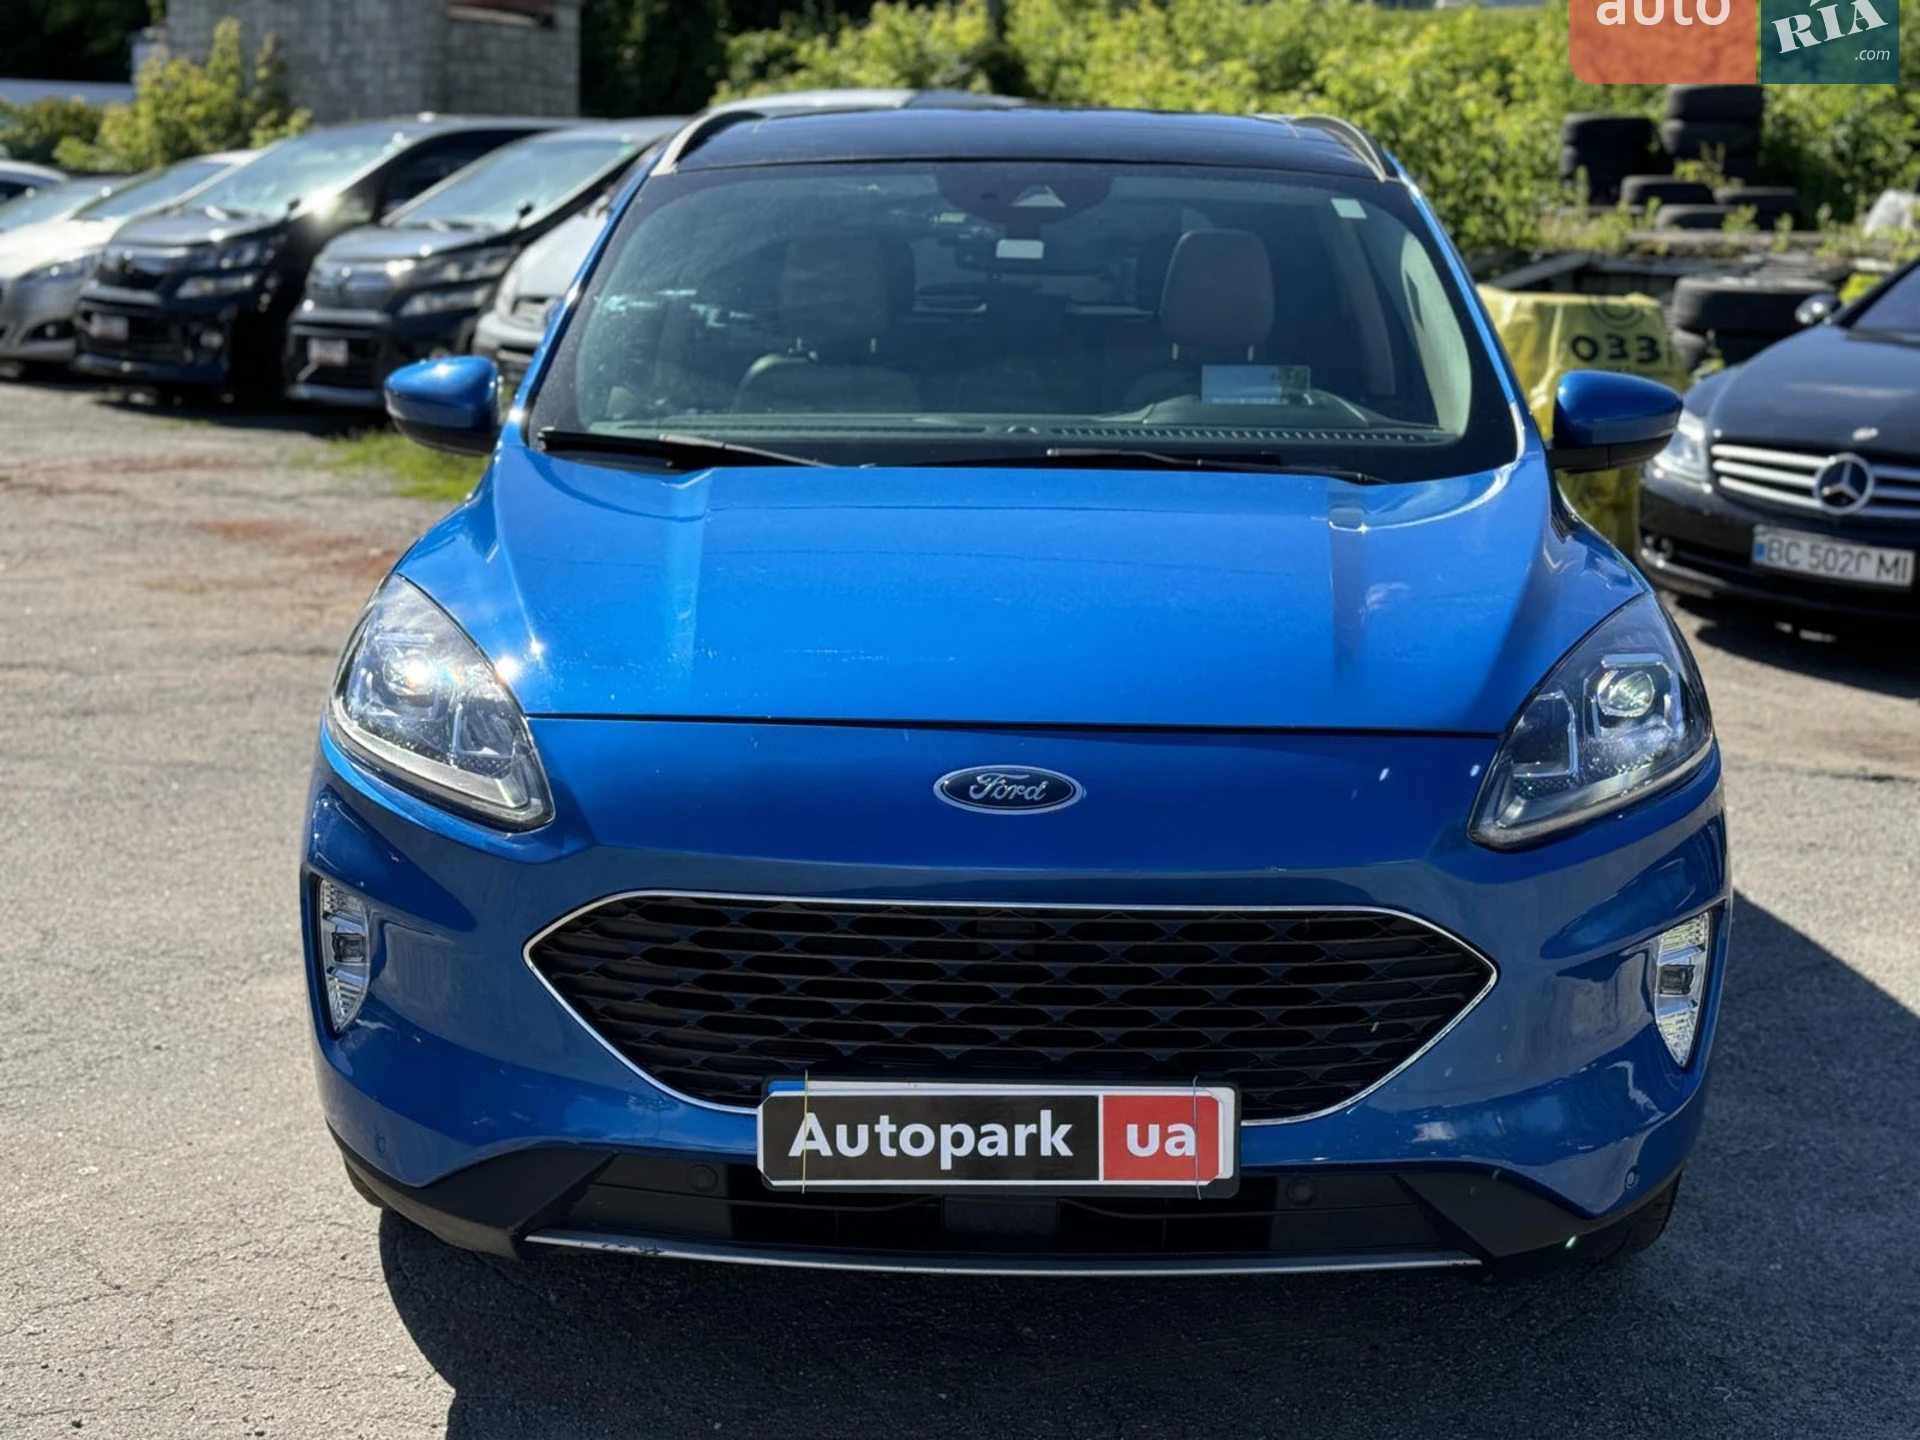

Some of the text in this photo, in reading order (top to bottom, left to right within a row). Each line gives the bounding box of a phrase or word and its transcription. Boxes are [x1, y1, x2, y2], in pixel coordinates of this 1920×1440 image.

[1571, 333, 1662, 365] 033
[968, 772, 1049, 801] Ford
[787, 1109, 1197, 1170] Autopark ua
